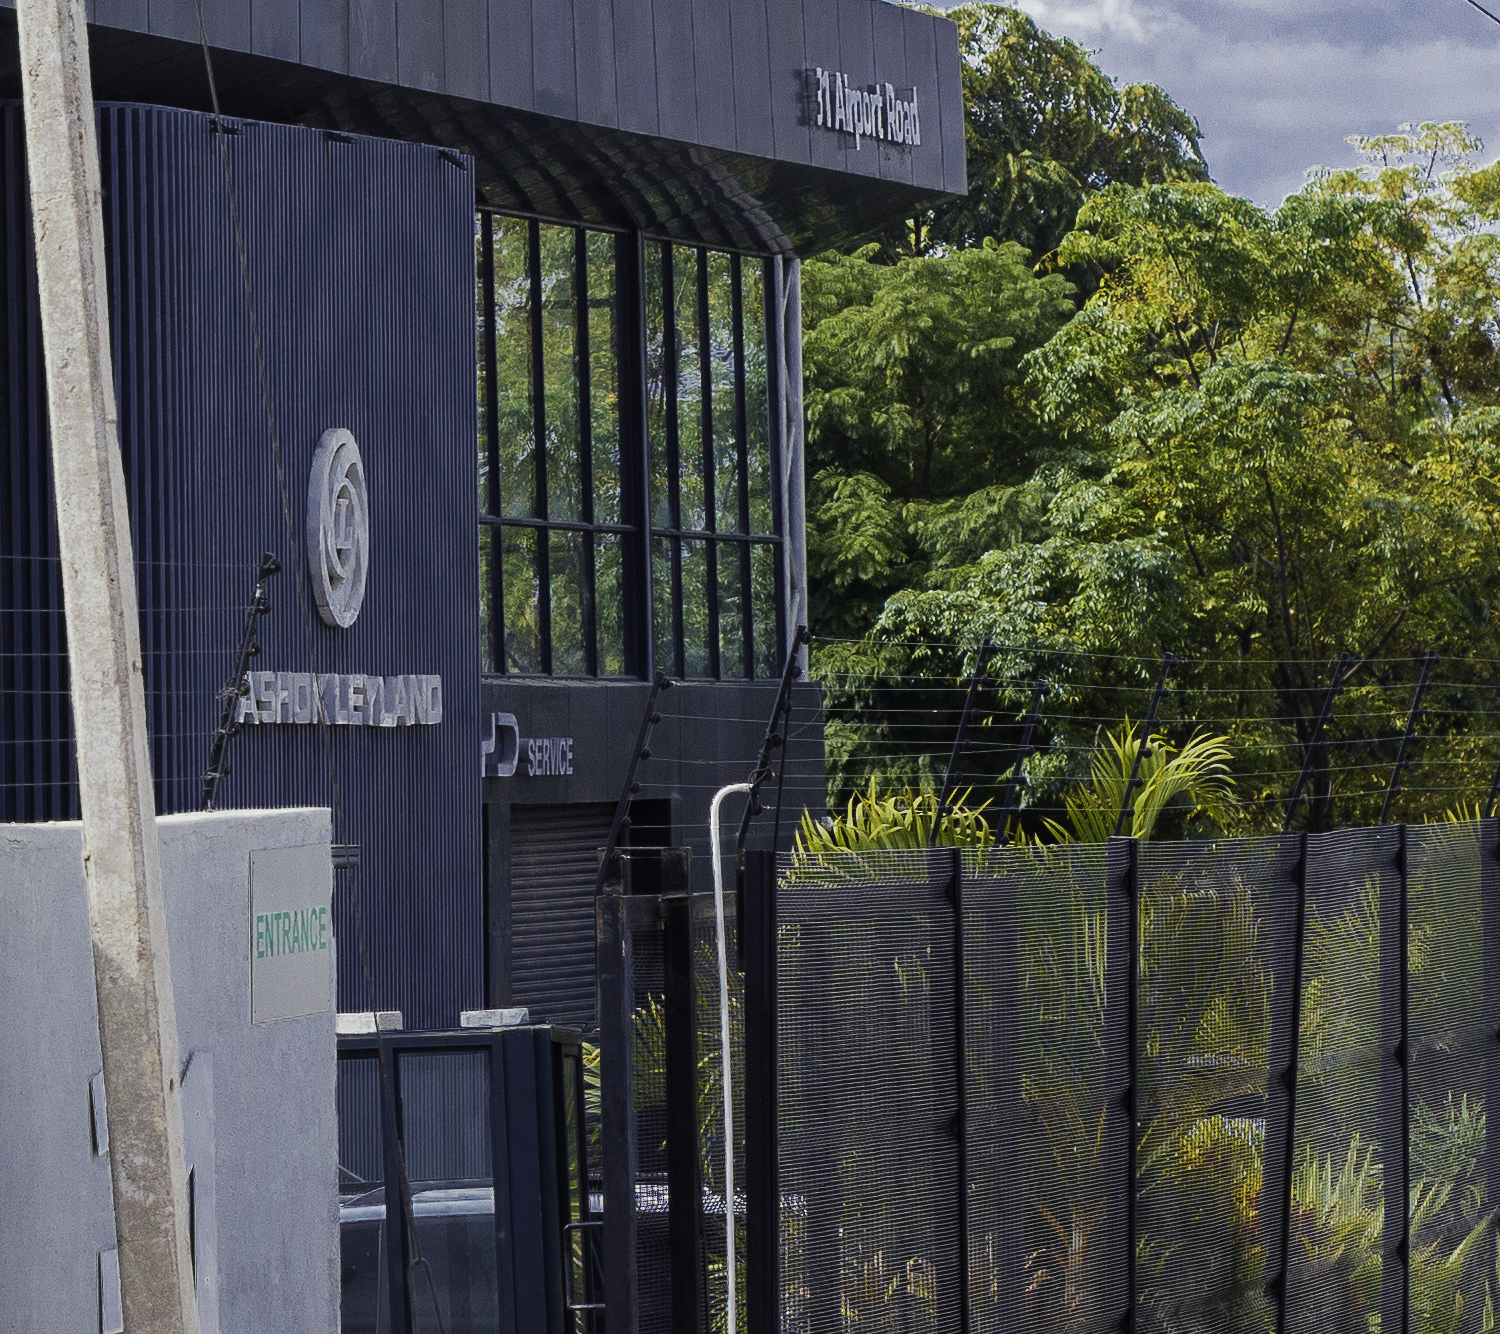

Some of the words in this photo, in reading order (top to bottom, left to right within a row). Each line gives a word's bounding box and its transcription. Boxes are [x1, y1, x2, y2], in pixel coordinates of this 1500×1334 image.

[815, 66, 832, 128] 31
[835, 72, 883, 151] Airport
[885, 82, 921, 146] Road
[234, 670, 335, 726] ASHOK
[335, 673, 443, 728] LEYLAND
[527, 737, 573, 777] SERVICE
[255, 906, 328, 959] ENTRANCE
